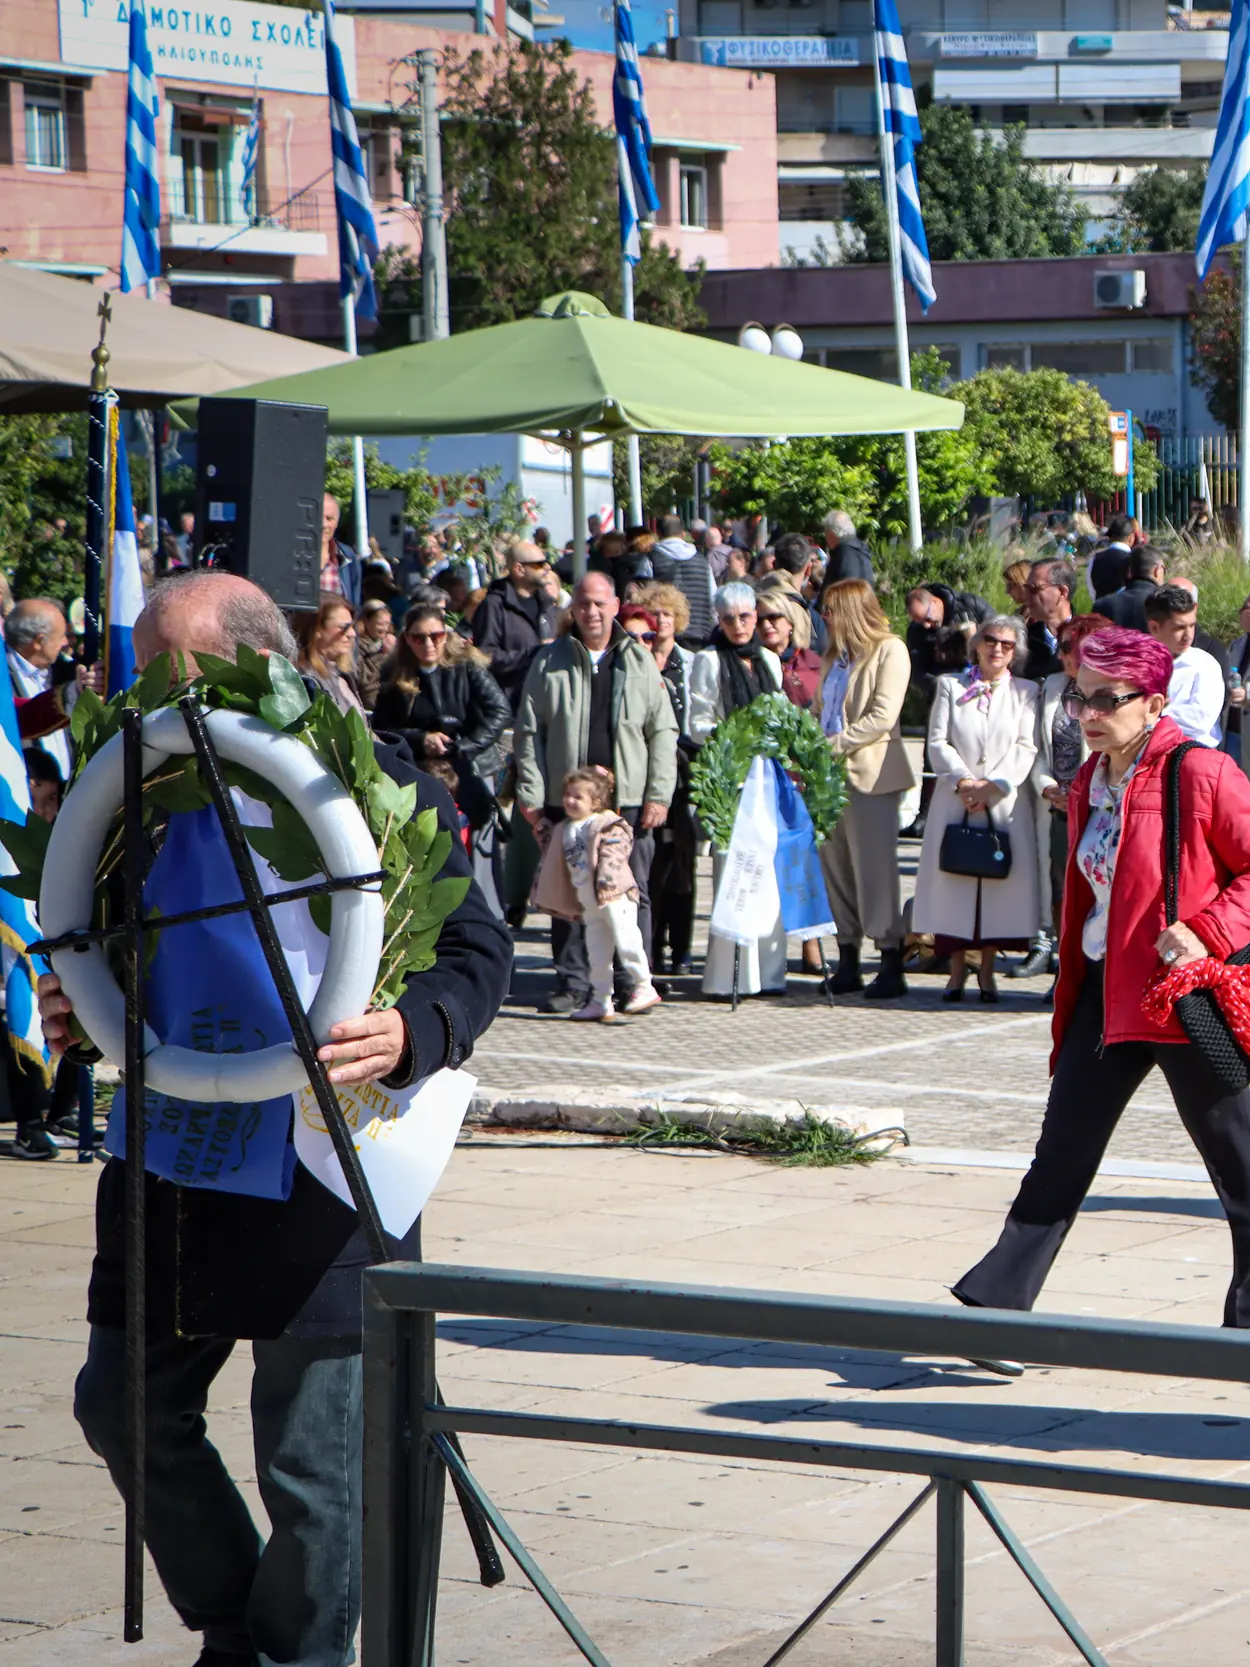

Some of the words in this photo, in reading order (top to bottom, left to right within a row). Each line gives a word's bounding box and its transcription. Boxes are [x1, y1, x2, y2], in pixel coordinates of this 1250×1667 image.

[116, 2, 232, 36] ΔΜΟΤΙΚΟ
[251, 19, 325, 50] ΣΧΟΛΕΙ
[157, 44, 264, 71] ΗΛΙΟΥΠΟΛΗΣ
[727, 39, 853, 56] ΦΥΣΙΚΟΘΕΡΑΠΕΙΑ
